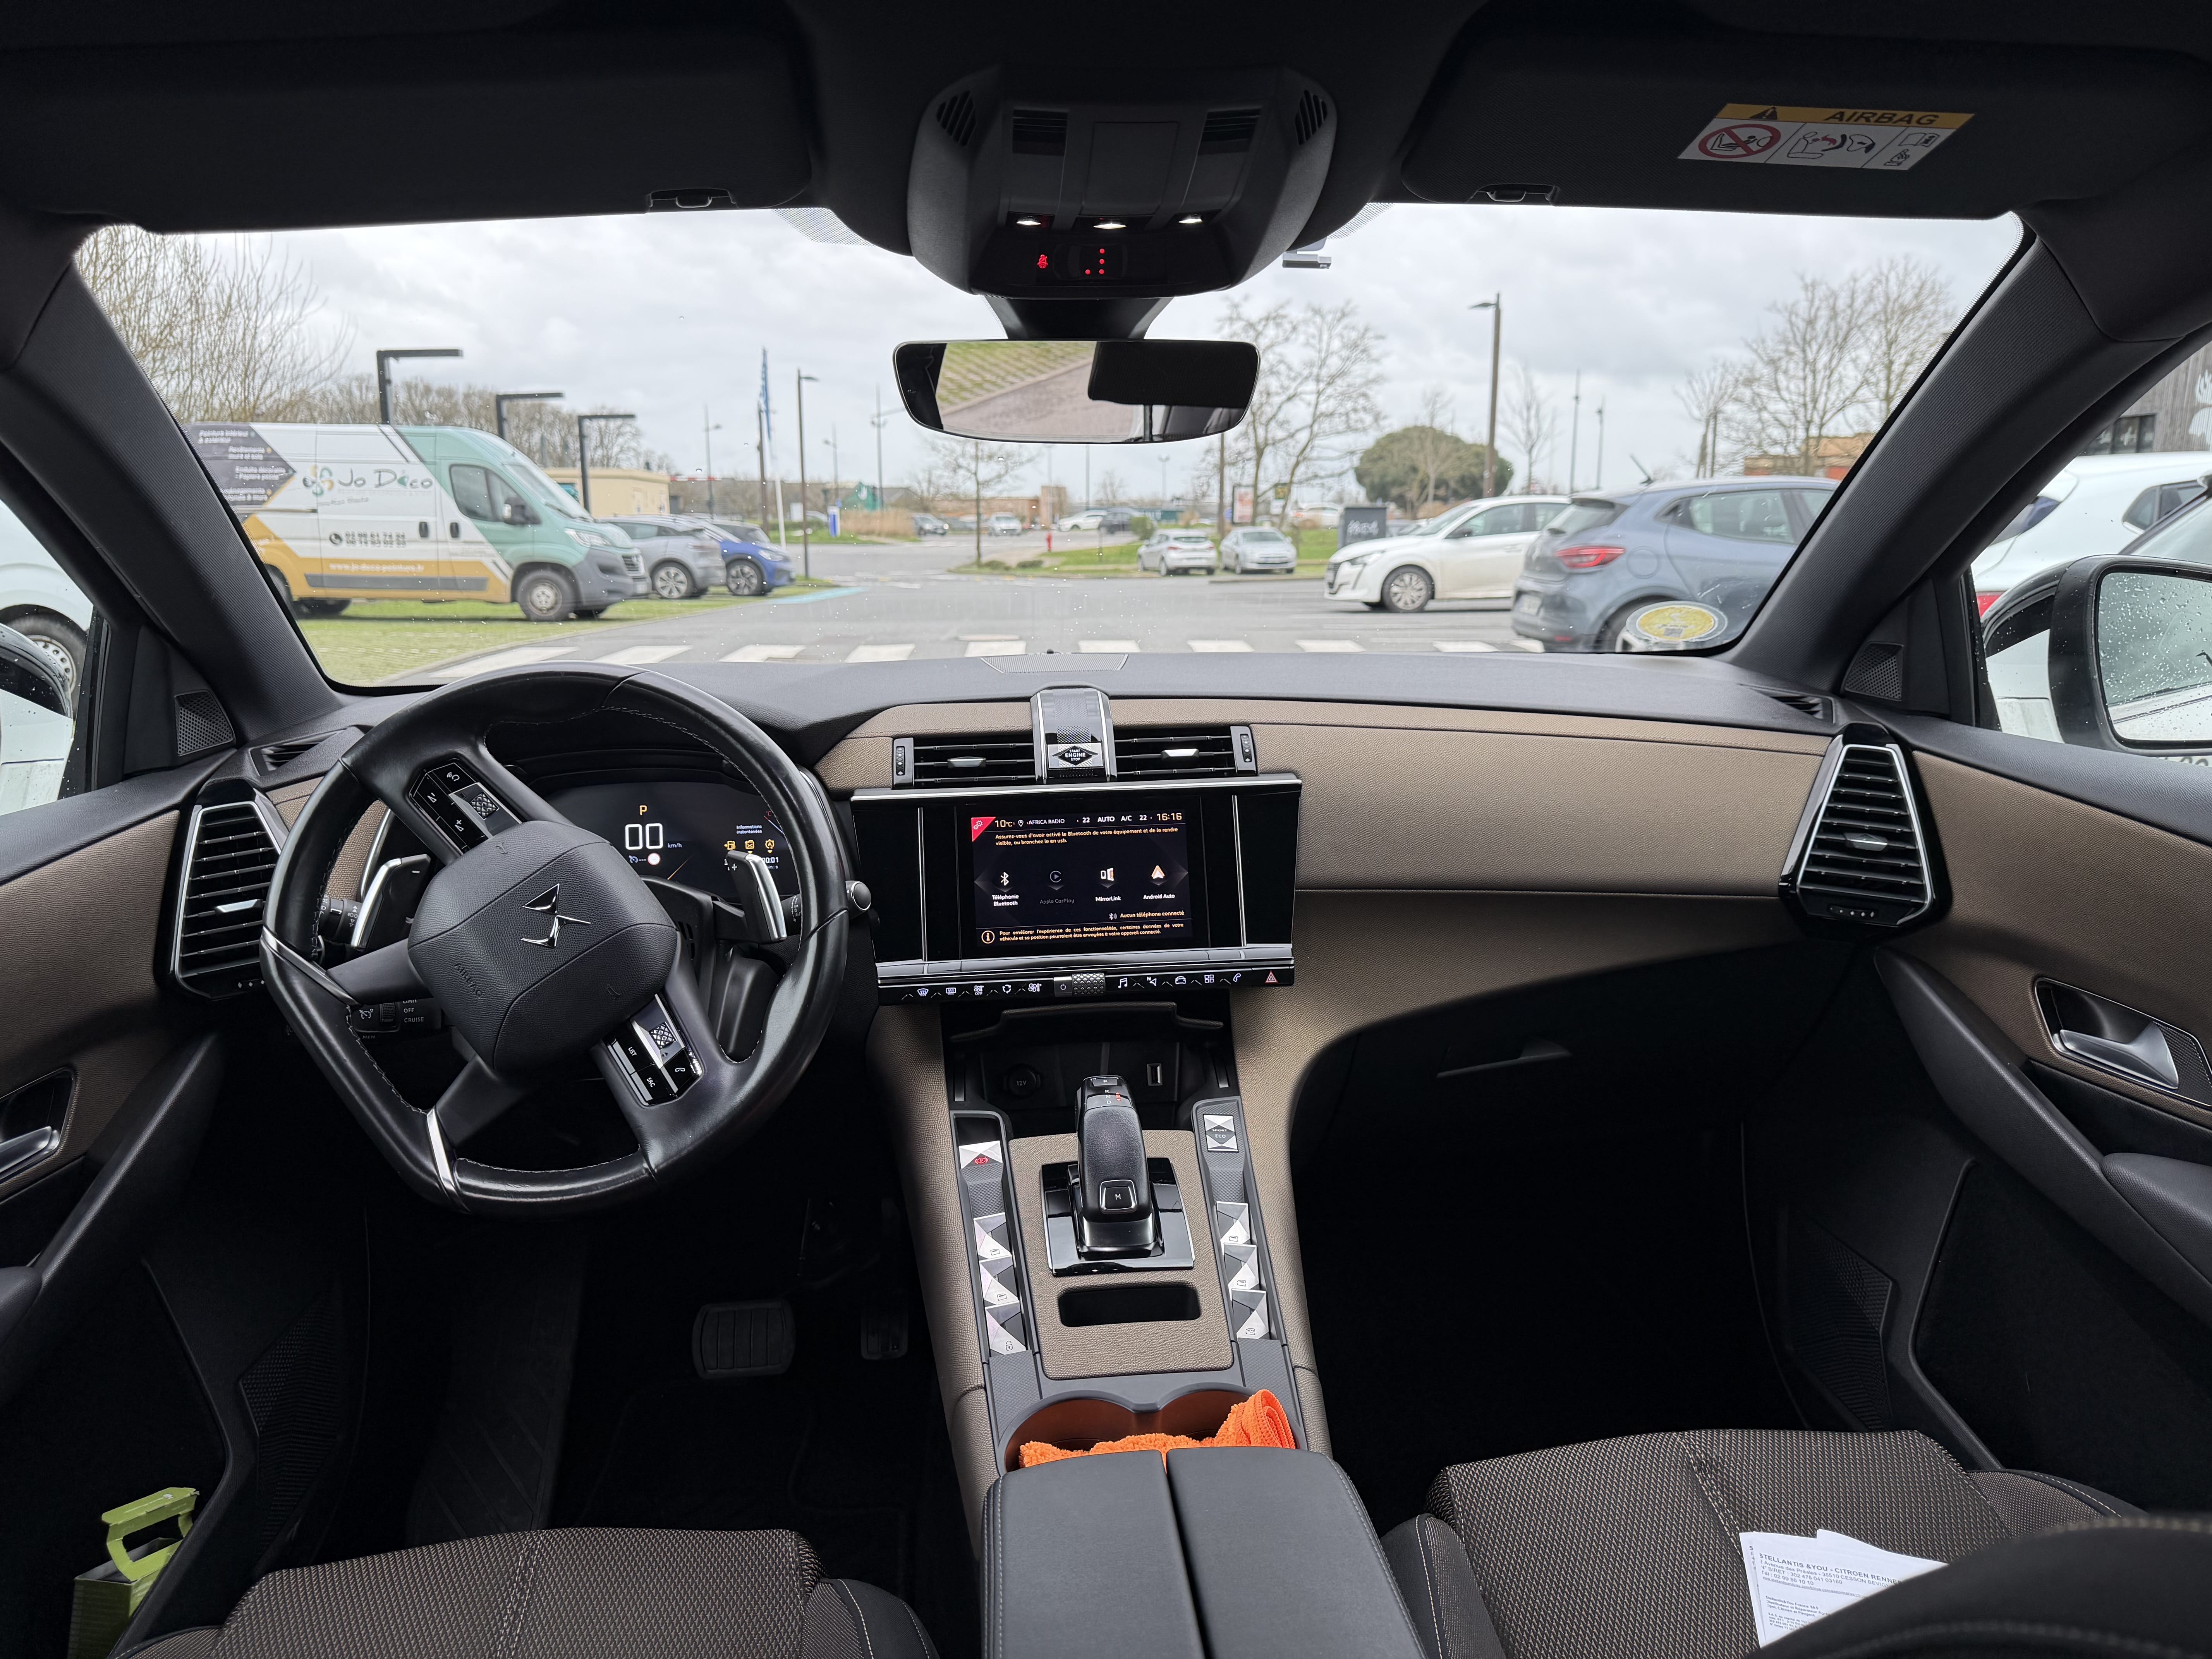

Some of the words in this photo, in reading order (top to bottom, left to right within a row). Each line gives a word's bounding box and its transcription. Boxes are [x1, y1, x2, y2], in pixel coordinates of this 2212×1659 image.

[1824, 110, 1940, 126] AIRBAG
[337, 468, 366, 488] Jo
[639, 805, 647, 816] P
[1156, 812, 1182, 821] 16:16
[995, 819, 1013, 828] 10°C
[625, 823, 663, 850] 00
[627, 1046, 638, 1057] LIST
[646, 1077, 656, 1088] SRC
[1759, 1553, 1804, 1568] STELLANTIS
[1835, 1568, 1869, 1578] CITROEN
[1764, 1561, 1784, 1570] Avenue
[1768, 1566, 1786, 1575] SIRET
